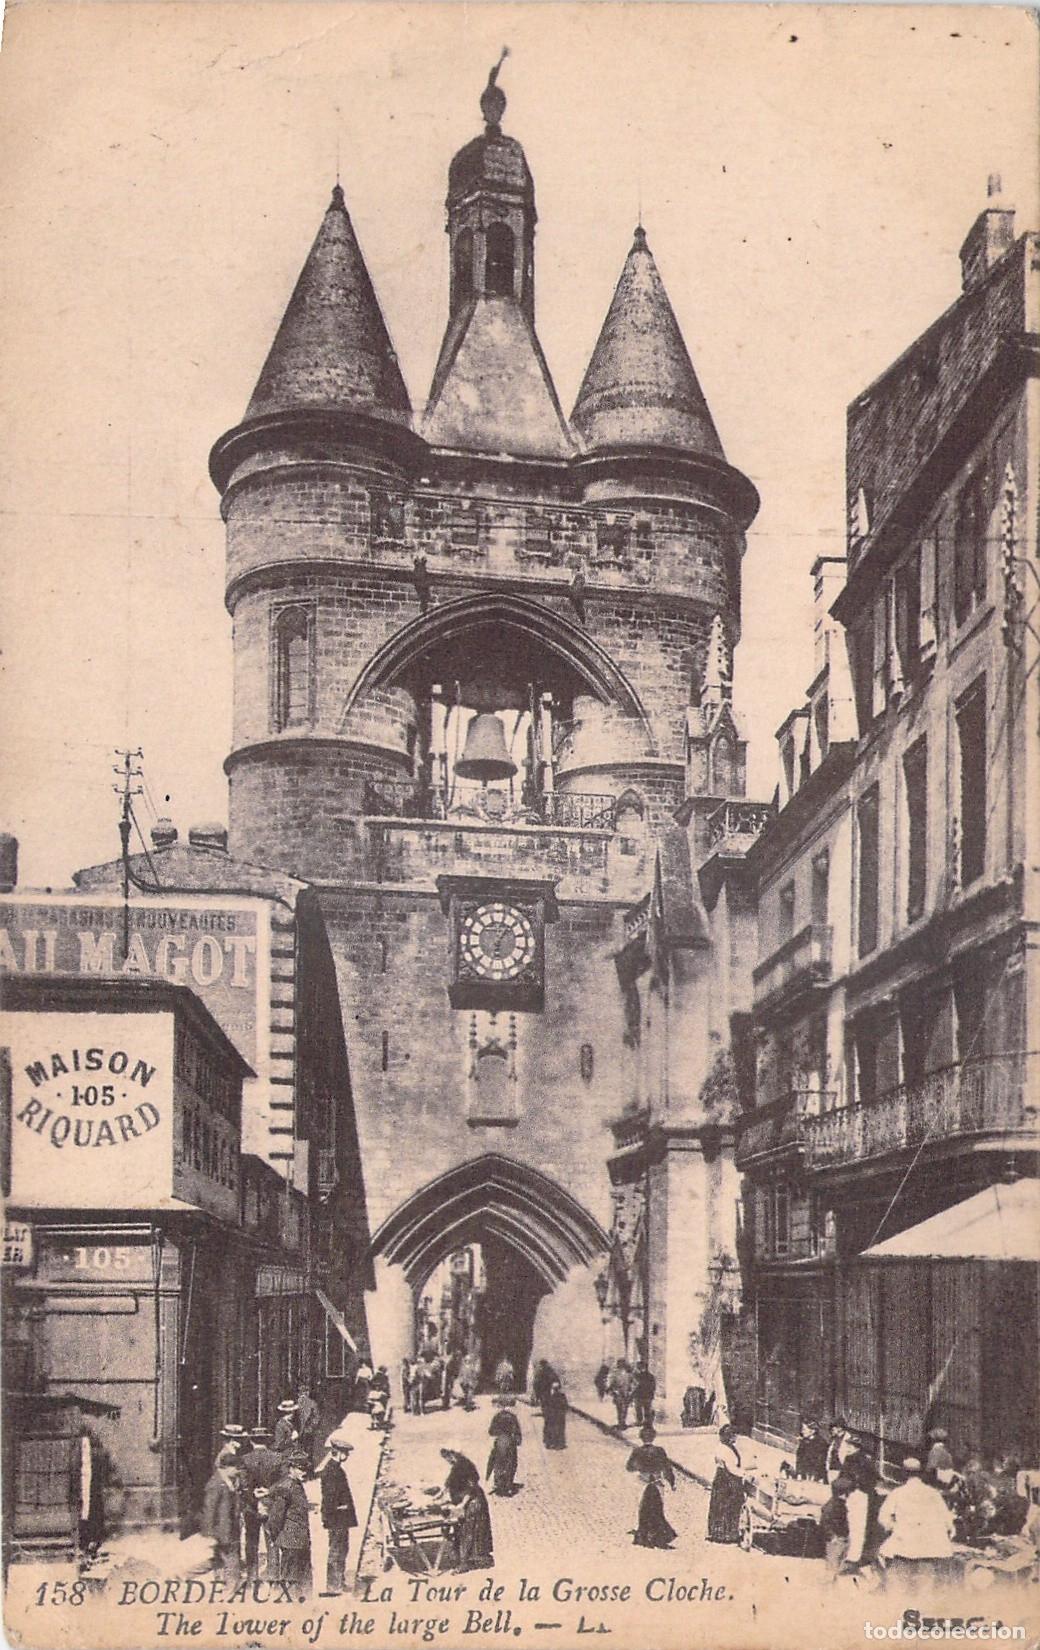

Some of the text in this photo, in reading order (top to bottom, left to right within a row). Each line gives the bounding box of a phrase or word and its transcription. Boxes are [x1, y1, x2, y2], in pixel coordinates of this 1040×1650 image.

[77, 931, 257, 988] MAGOT
[24, 1048, 157, 1088] MAISON
[16, 1097, 161, 1148] RIQUARD
